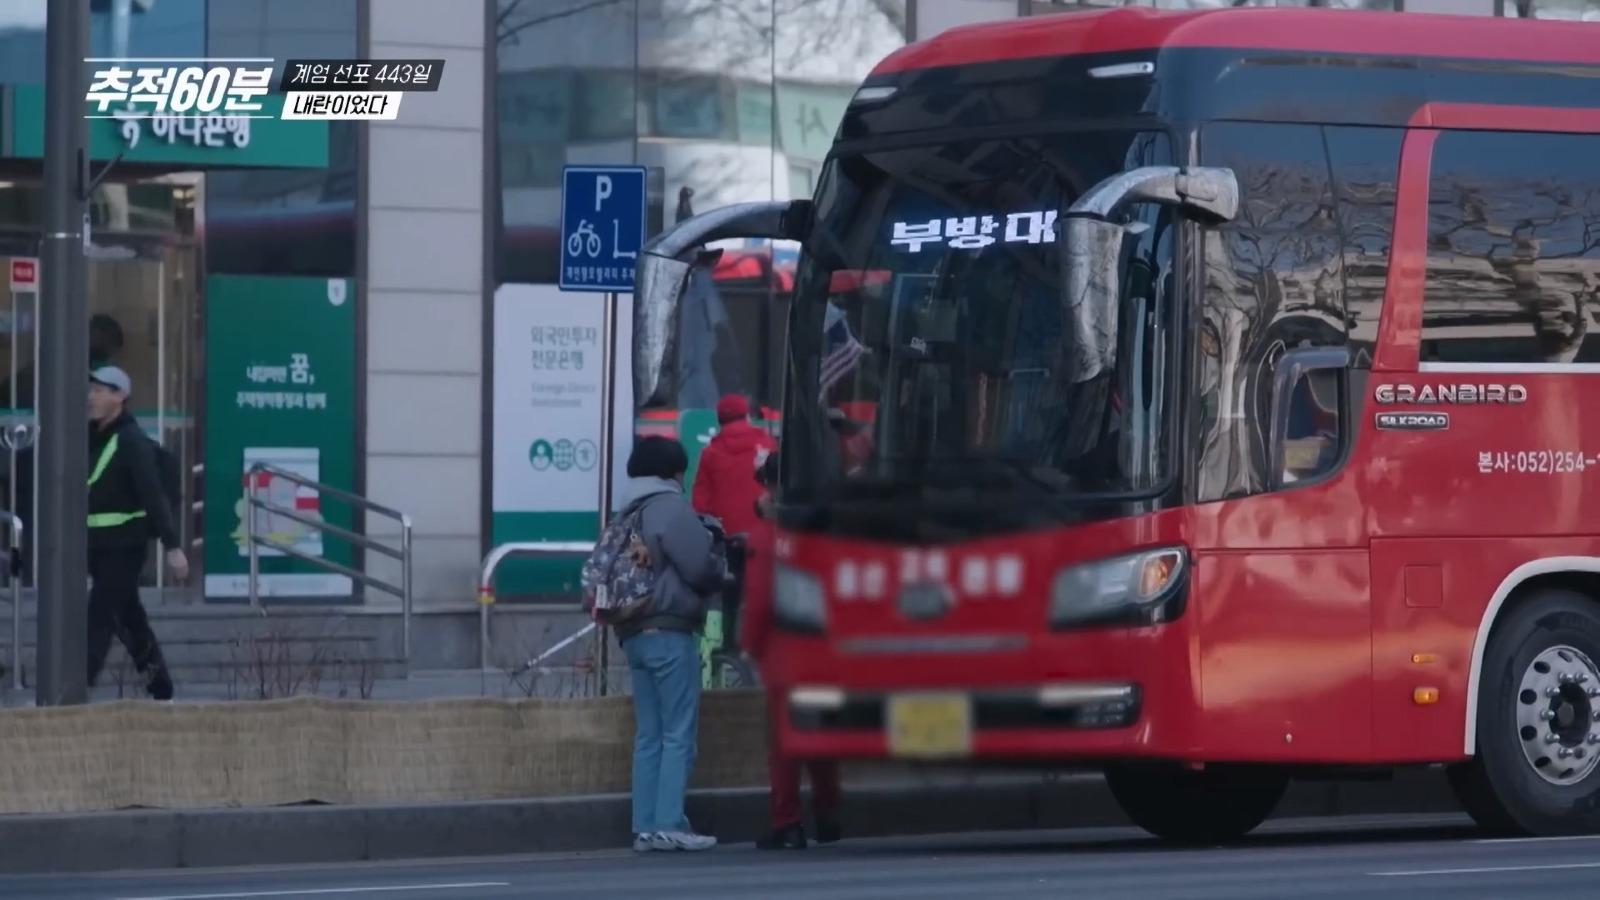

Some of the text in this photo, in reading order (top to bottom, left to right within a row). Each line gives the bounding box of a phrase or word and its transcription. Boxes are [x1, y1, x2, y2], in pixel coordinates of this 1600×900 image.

[151, 111, 251, 148] 하나은행
[595, 174, 613, 212] P
[890, 209, 1058, 253] 부방대
[1375, 383, 1528, 404] GRANBIRD
[1380, 415, 1447, 427] SILKROAD
[1477, 449, 1600, 474] 본사:052)254-
